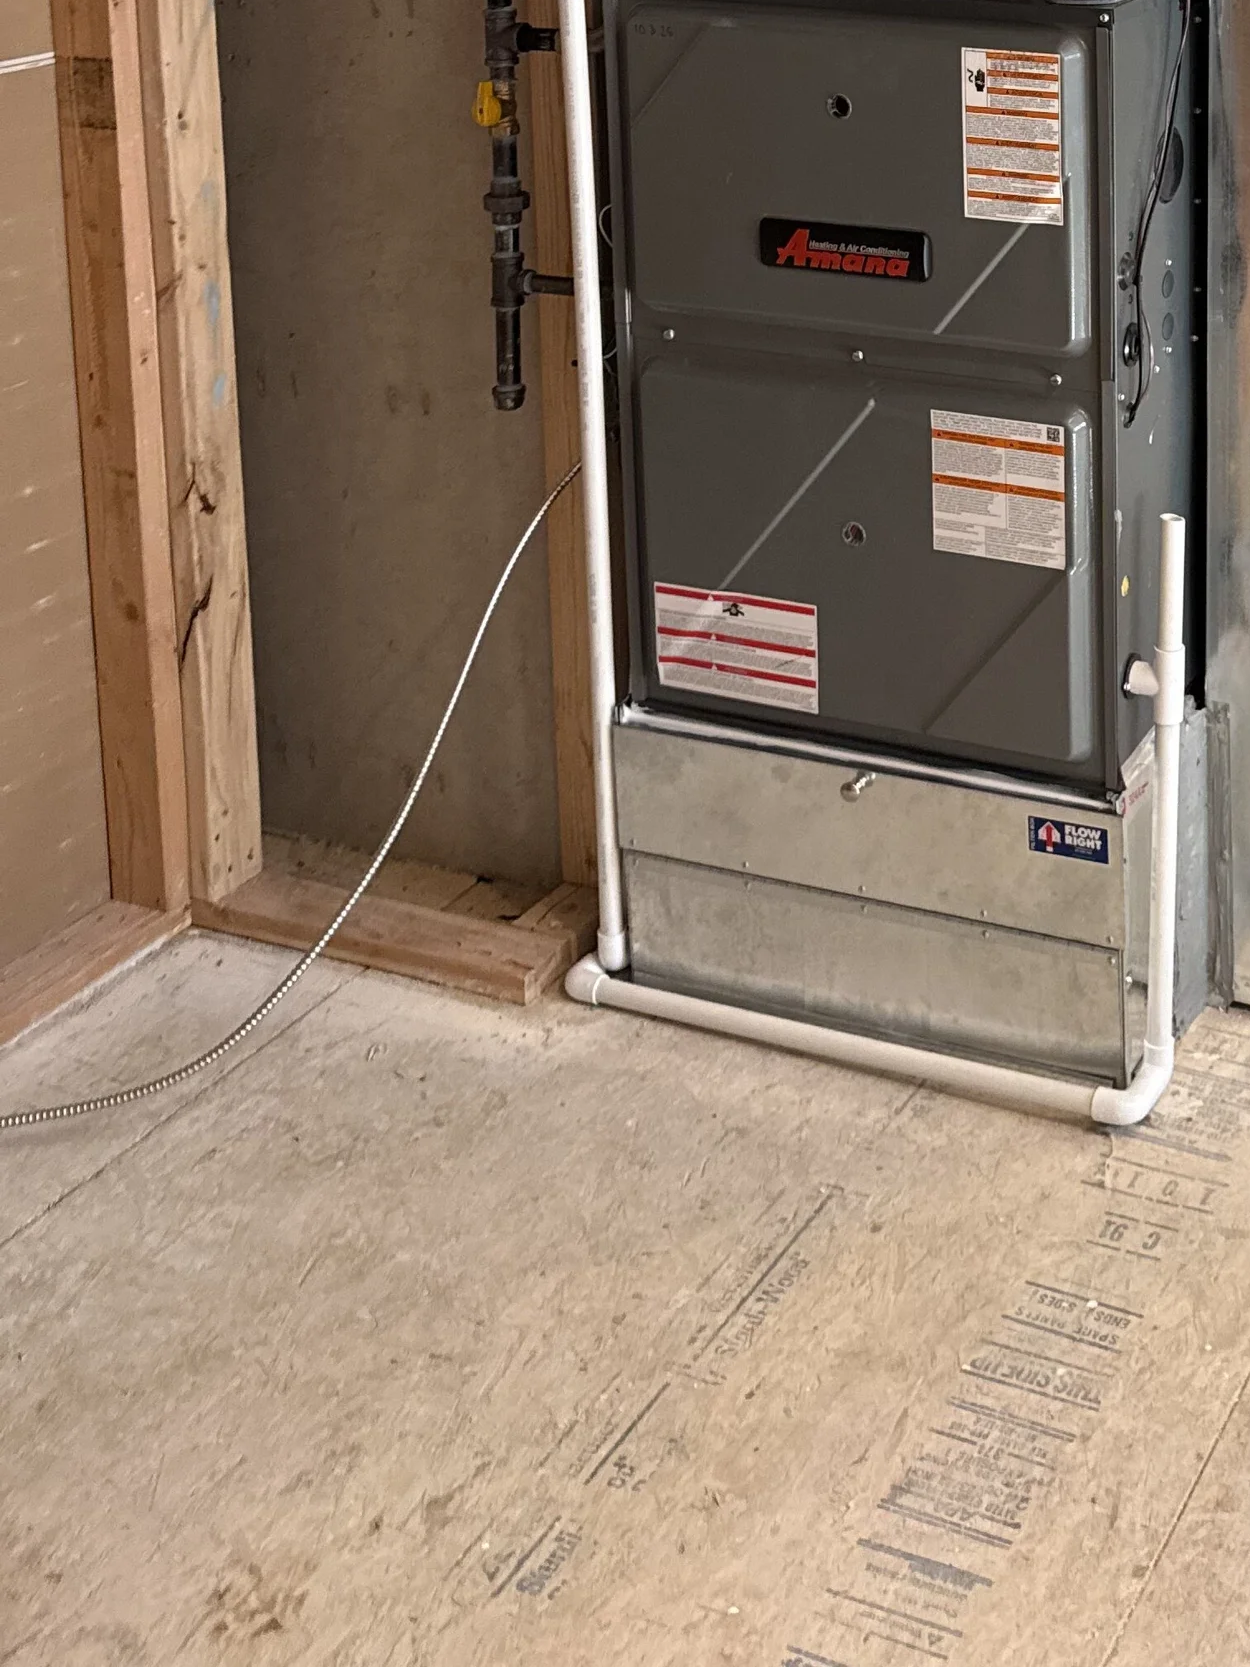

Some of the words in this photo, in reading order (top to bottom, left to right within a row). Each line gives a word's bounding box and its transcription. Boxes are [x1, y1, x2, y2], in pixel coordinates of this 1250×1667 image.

[776, 229, 911, 277] Amana
[809, 240, 838, 251] Heating
[840, 243, 845, 251] &
[847, 243, 858, 253] Air
[860, 245, 910, 258] Conditioning
[1065, 824, 1101, 840] FLOW
[1065, 835, 1102, 850] RIGHT
